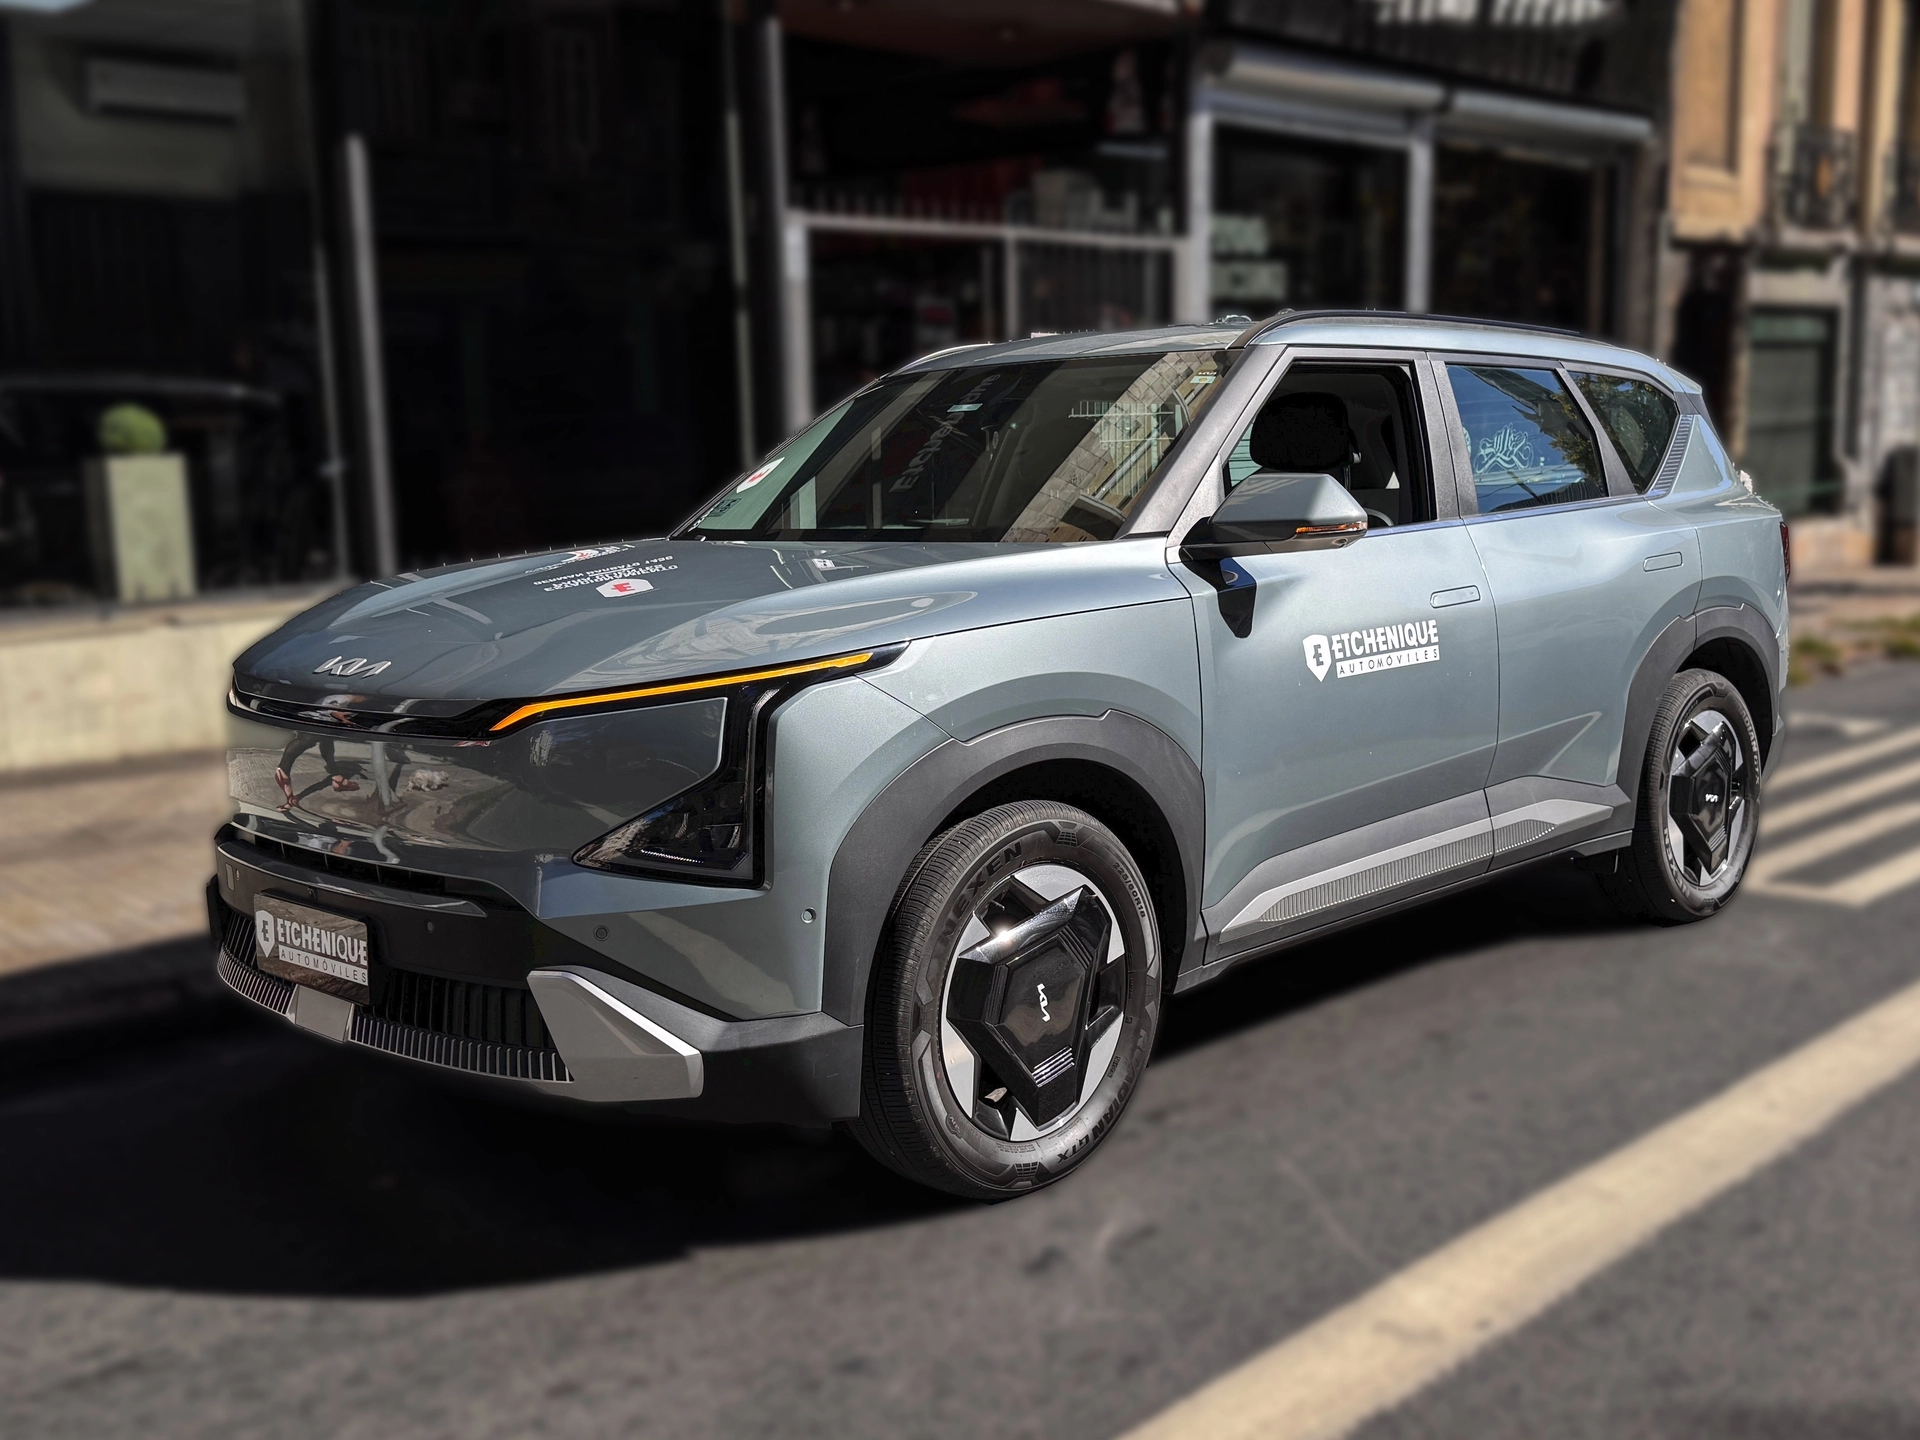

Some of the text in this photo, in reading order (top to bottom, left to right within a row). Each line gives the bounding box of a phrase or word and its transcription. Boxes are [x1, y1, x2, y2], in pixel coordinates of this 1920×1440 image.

[1331, 619, 1439, 660] ETCHENIQUE
[1339, 648, 1438, 675] AUTOMÓVILES
[938, 842, 1022, 948] NEXEN
[276, 917, 368, 966] ETCHENIQUE
[281, 949, 367, 983] AUTOMÓVILES
[1057, 1134, 1090, 1163] GTX
